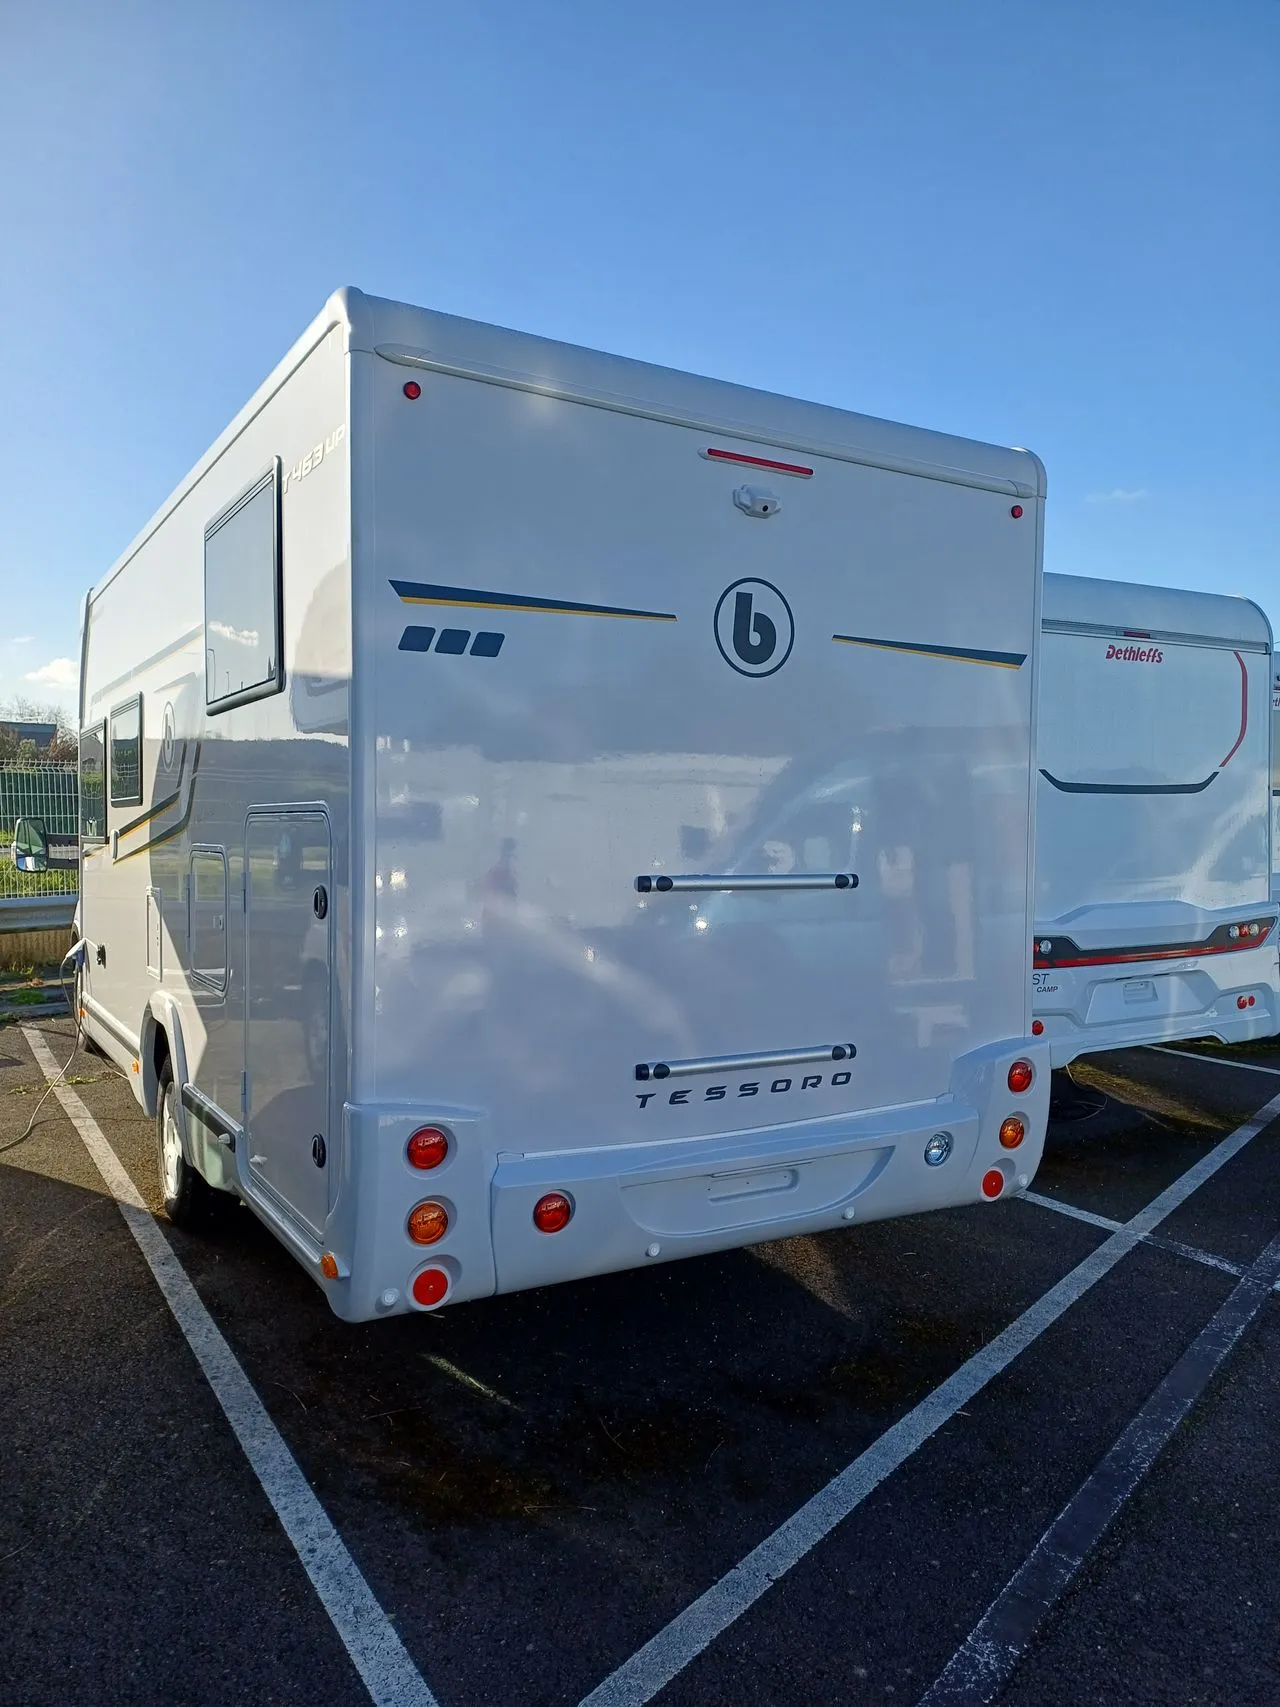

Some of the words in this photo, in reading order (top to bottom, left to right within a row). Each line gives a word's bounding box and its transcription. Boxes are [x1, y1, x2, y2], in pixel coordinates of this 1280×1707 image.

[1105, 644, 1164, 663] Dethleffs
[1032, 973, 1050, 986] ST
[635, 1071, 852, 1109] TESSORO
